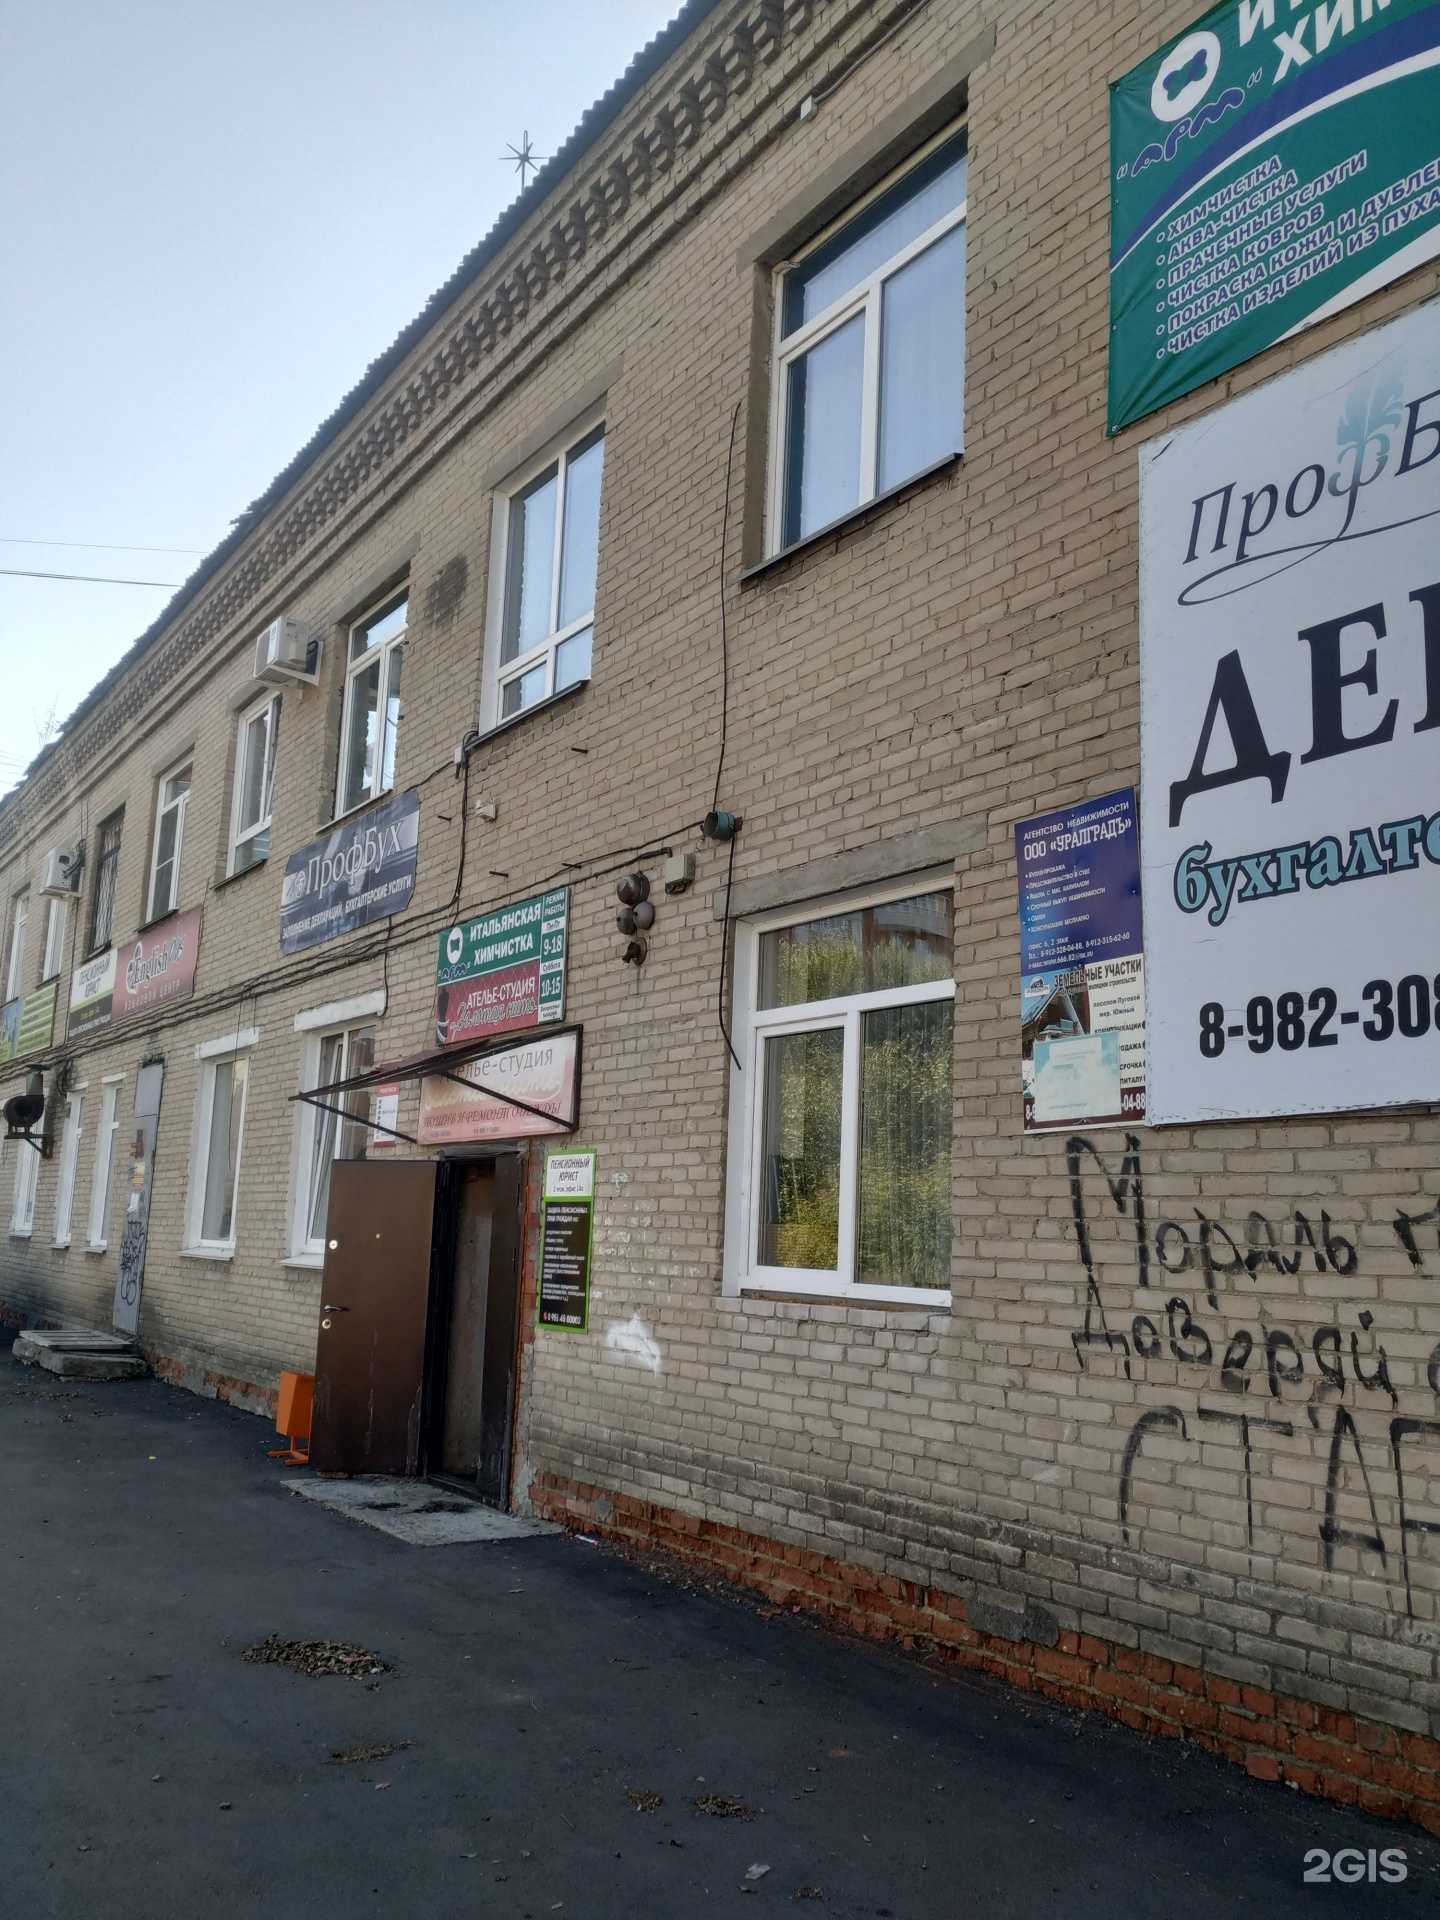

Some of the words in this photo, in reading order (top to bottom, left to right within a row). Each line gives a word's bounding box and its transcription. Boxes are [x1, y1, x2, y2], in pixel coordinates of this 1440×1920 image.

[1168, 155, 1282, 241] ХИМЧИСТКА
[1168, 169, 1298, 264] АКВА-ЧИСТКА
[1168, 200, 1283, 286] ПРАЧЕЧНЫЕ
[1284, 149, 1367, 215] УСЛУГИ
[1168, 262, 1268, 334] ПОКРАСКА
[1269, 221, 1334, 275] КОЖИ
[1338, 207, 1356, 235] И
[1358, 157, 1440, 227] ДУБЛЕ
[1168, 254, 1240, 306] ЧИСТКА
[1242, 202, 1324, 266] КОВРОВ
[1168, 302, 1240, 355] ЧИСТКА
[1242, 238, 1343, 316] ИЗДЕЛИЙ
[1347, 222, 1379, 256] ИЗ
[1024, 822, 1064, 840] АГЕНТСТВО
[1067, 800, 1130, 828] НЕДВИЖИМОСТИ
[306, 822, 402, 900] ПрофБух
[1023, 840, 1047, 861] ООО
[469, 902, 542, 942] ИТАЛЬЯНСКАЯ
[474, 932, 534, 966] ХИМЧИСТКА
[543, 934, 563, 956] 9-18
[541, 976, 561, 998] 10-15
[1054, 966, 1103, 988] ЗЕМЕЛЬНЫЕ
[1104, 958, 1142, 978] УЧАСТКИ
[466, 977, 536, 1010] АТЕЛЬЕ-СТУДИЯ
[1199, 974, 1440, 1058] 8-982-30
[1120, 1042, 1142, 1052] ОДАЖА
[551, 1155, 591, 1169] ПЕНСИОННЫЙ
[559, 1170, 579, 1182] ЮРИСТ
